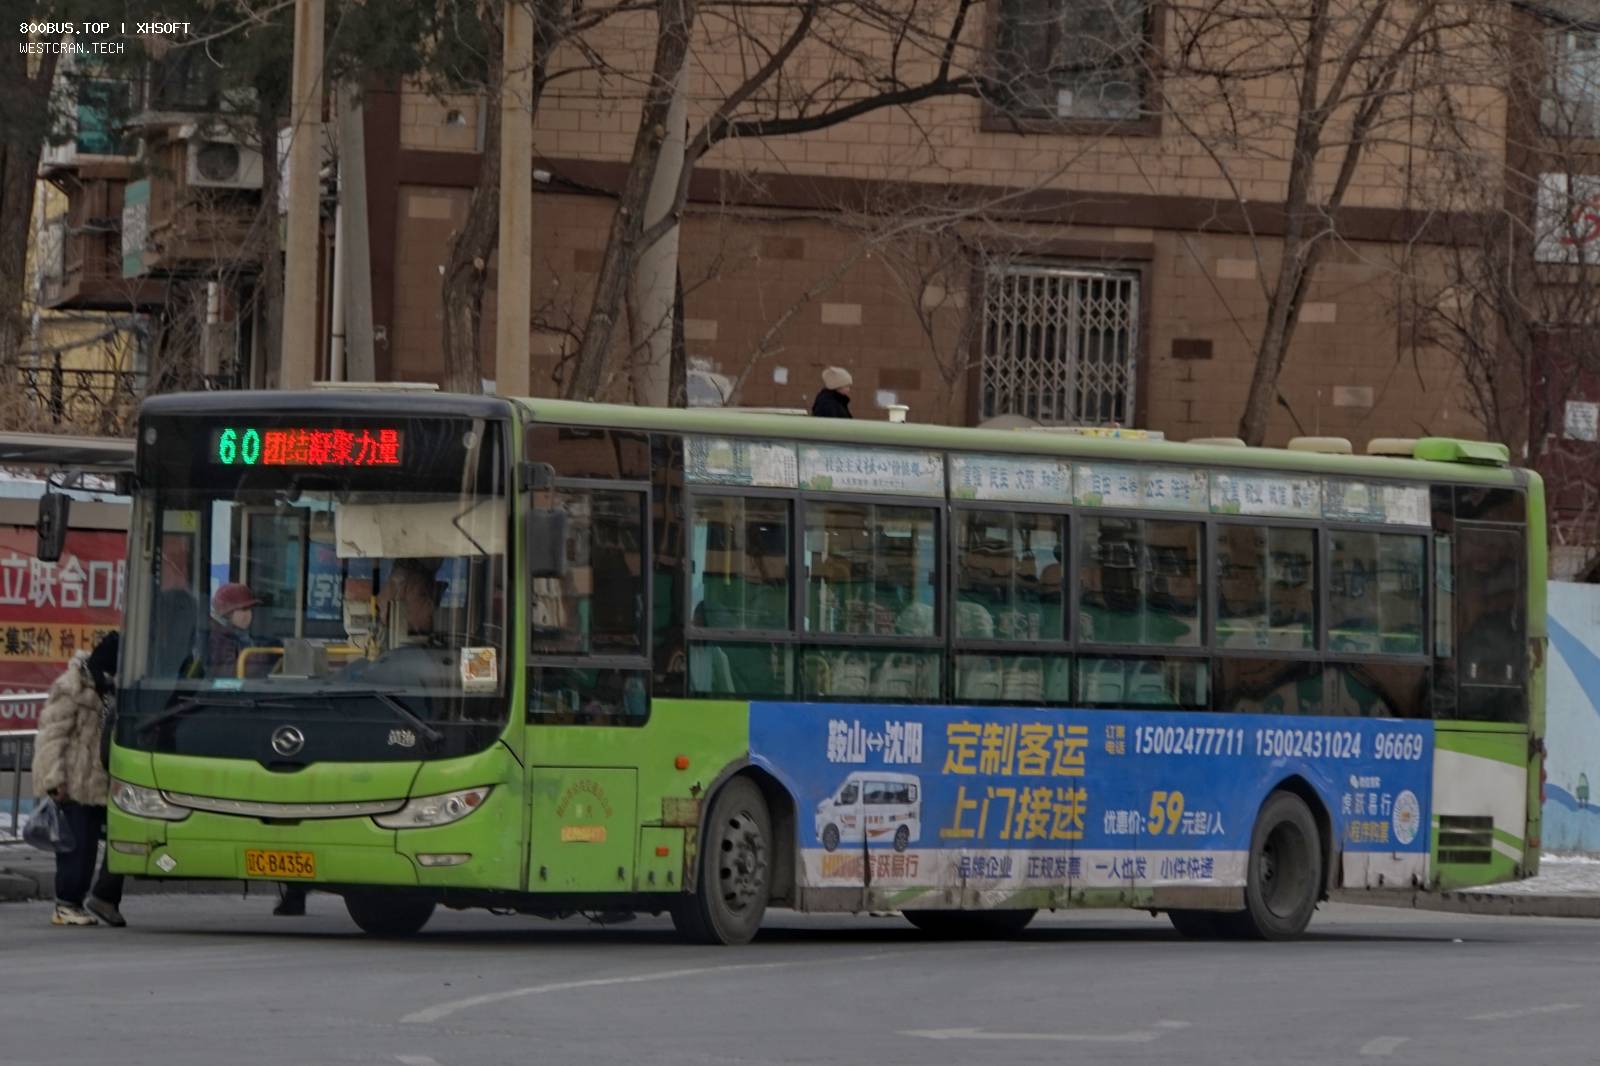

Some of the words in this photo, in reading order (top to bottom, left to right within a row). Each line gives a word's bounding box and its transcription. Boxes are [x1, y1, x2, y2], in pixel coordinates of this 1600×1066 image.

[219, 428, 260, 464] 60
[827, 719, 866, 764] 鞍山
[883, 721, 924, 764] 沈阳
[942, 722, 1089, 776] 定制客运
[1134, 726, 1245, 756] 15002477711
[1255, 729, 1362, 759] 15002431024
[1374, 732, 1424, 761] 96669
[939, 786, 1088, 840] 上门接送
[957, 855, 1013, 880] 品牌企业
[1026, 856, 1082, 881] 正规发票
[1095, 856, 1148, 879] 一人也发
[1160, 856, 1214, 880] 小件快递
